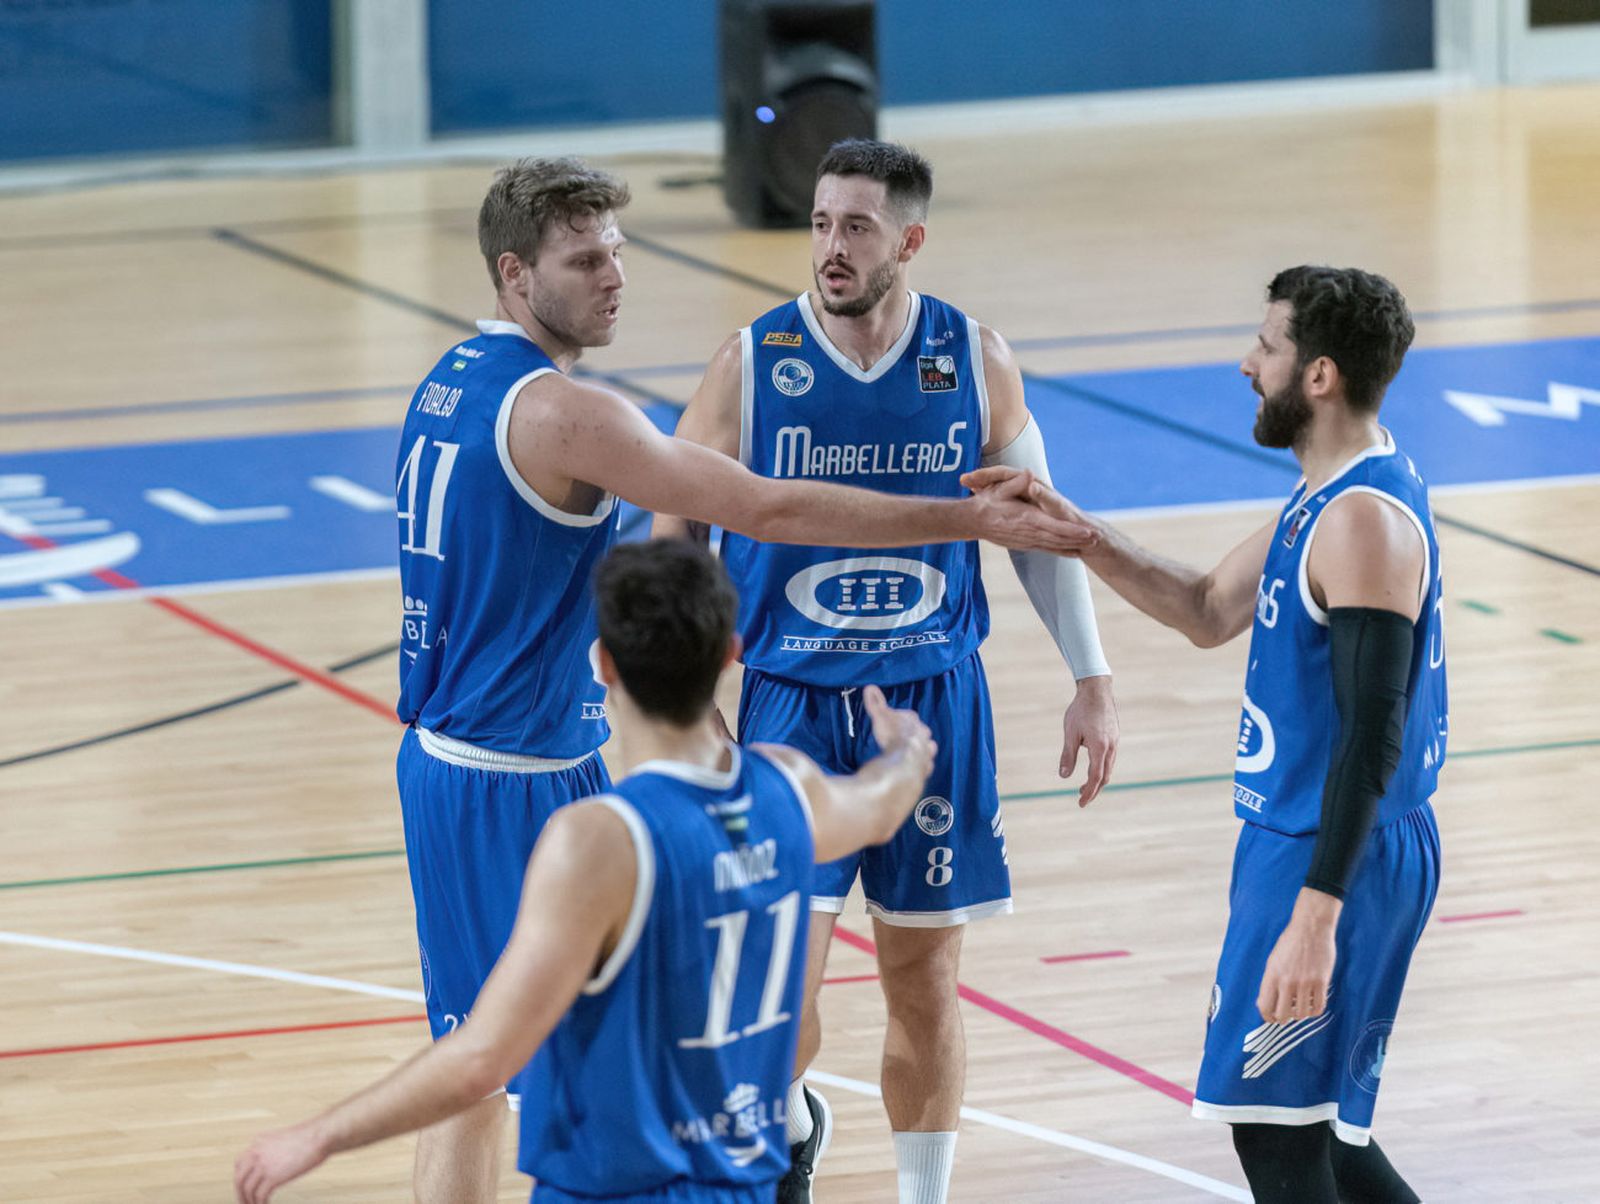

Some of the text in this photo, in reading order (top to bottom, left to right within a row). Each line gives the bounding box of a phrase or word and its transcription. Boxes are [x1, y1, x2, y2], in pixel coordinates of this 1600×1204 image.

[416, 380, 463, 418] FIDALGO
[922, 381, 952, 389] PLATA
[773, 421, 967, 477] MARBELLEROS
[784, 639, 869, 651] LANGUAGE
[1233, 786, 1263, 809] OOLS
[925, 846, 954, 887] 8
[677, 890, 799, 1048] 11
